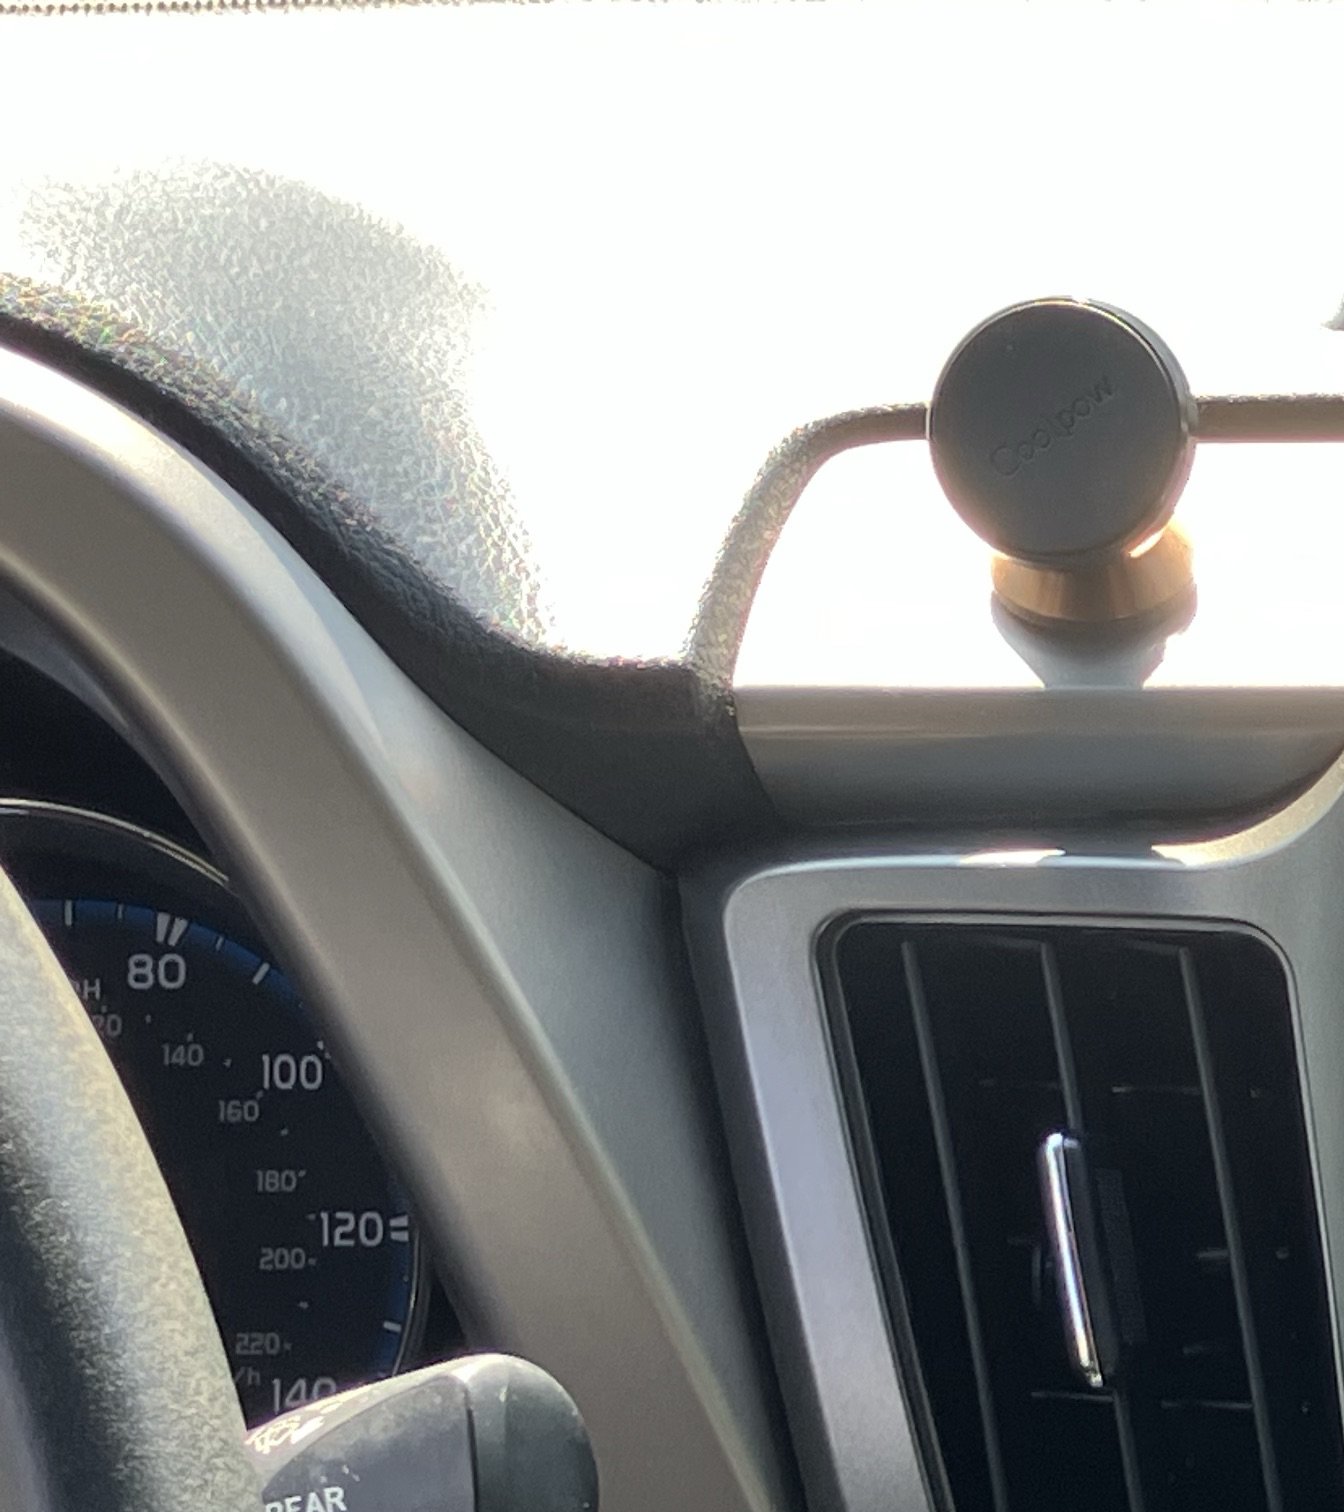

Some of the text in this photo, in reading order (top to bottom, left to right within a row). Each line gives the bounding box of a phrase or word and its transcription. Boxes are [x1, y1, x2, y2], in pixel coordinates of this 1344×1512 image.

[127, 953, 187, 990] 80
[161, 1042, 205, 1067] 140
[261, 1054, 324, 1090] 100
[218, 1099, 260, 1123] 160
[256, 1169, 297, 1192] 180
[319, 1211, 385, 1247] 120
[259, 1247, 307, 1270] 200
[235, 1332, 280, 1356] 220
